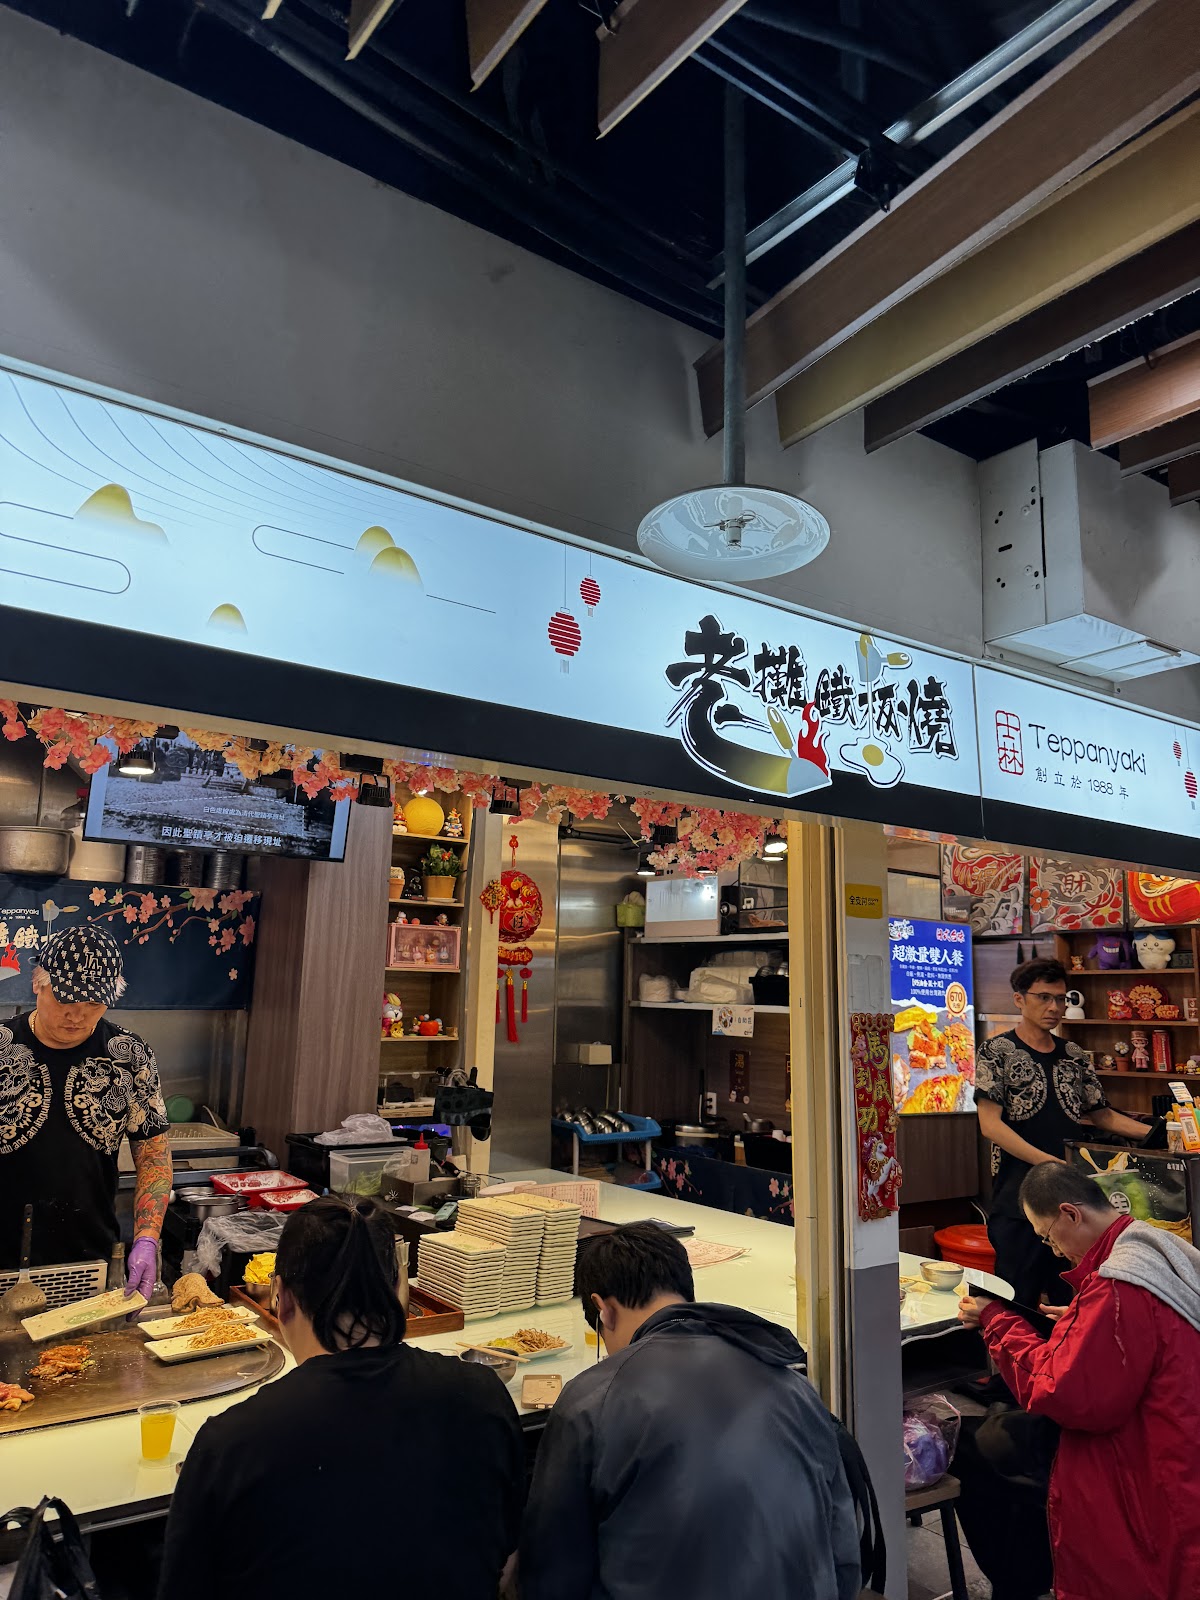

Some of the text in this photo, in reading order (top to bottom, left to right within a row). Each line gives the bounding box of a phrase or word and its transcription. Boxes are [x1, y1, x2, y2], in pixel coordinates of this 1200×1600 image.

[664, 614, 957, 797] 老攤鐵板燒
[996, 712, 1024, 775] 士林
[1028, 723, 1147, 775] Teppanyaki
[1088, 779, 1114, 795] 1988
[1062, 873, 1087, 896] 財
[83, 951, 102, 978] LA
[950, 991, 963, 1002] 670
[63, 1065, 80, 1101] wisdom
[12, 1134, 29, 1150] and
[26, 1126, 39, 1140] an
[38, 1063, 52, 1087] mind
[64, 1101, 76, 1118] and
